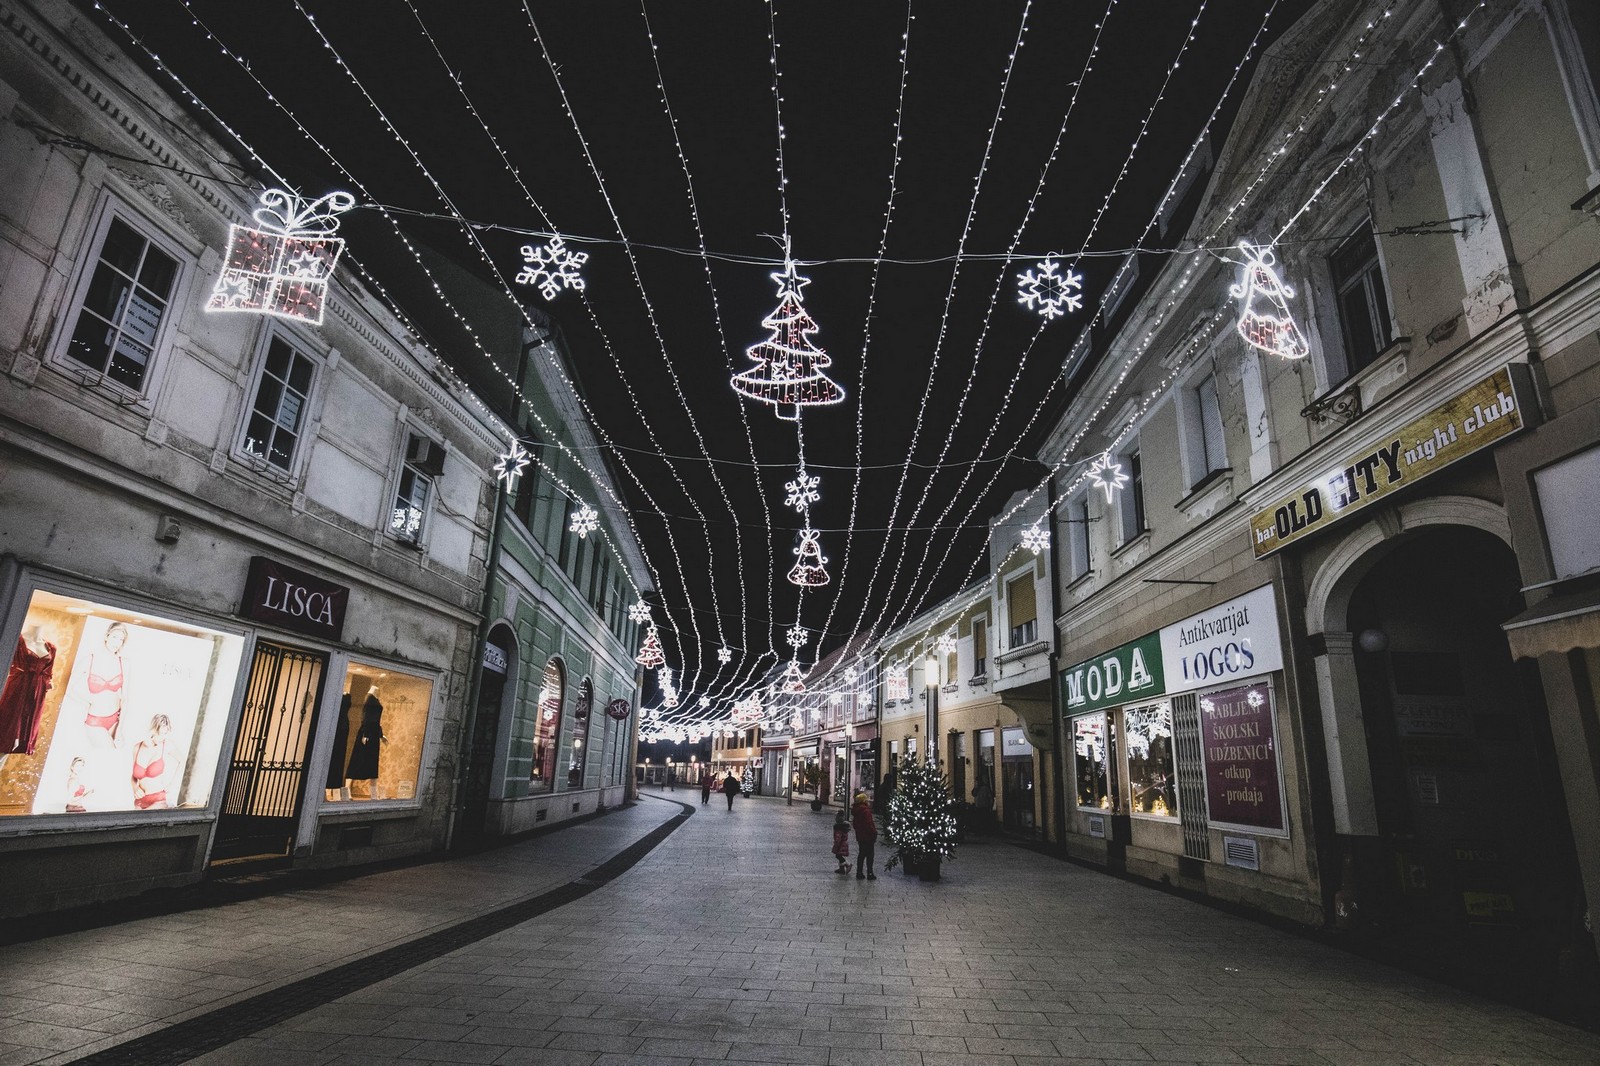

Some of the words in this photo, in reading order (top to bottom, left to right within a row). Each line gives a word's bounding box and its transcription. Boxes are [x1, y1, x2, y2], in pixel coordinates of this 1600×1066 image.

[1257, 521, 1276, 545] bar
[1274, 486, 1323, 541] OLD
[1327, 439, 1404, 512] CITY
[1404, 422, 1459, 467] night
[1463, 391, 1515, 436] club
[261, 575, 337, 627] LISCA
[1178, 604, 1251, 648] Antikvarijat
[1065, 647, 1154, 709] MODA
[1180, 637, 1255, 684] LOGOS
[1208, 700, 1261, 720] RABLJENI
[1212, 721, 1260, 740] ŠKOLSKI
[1209, 742, 1269, 761] UDŽBENICI
